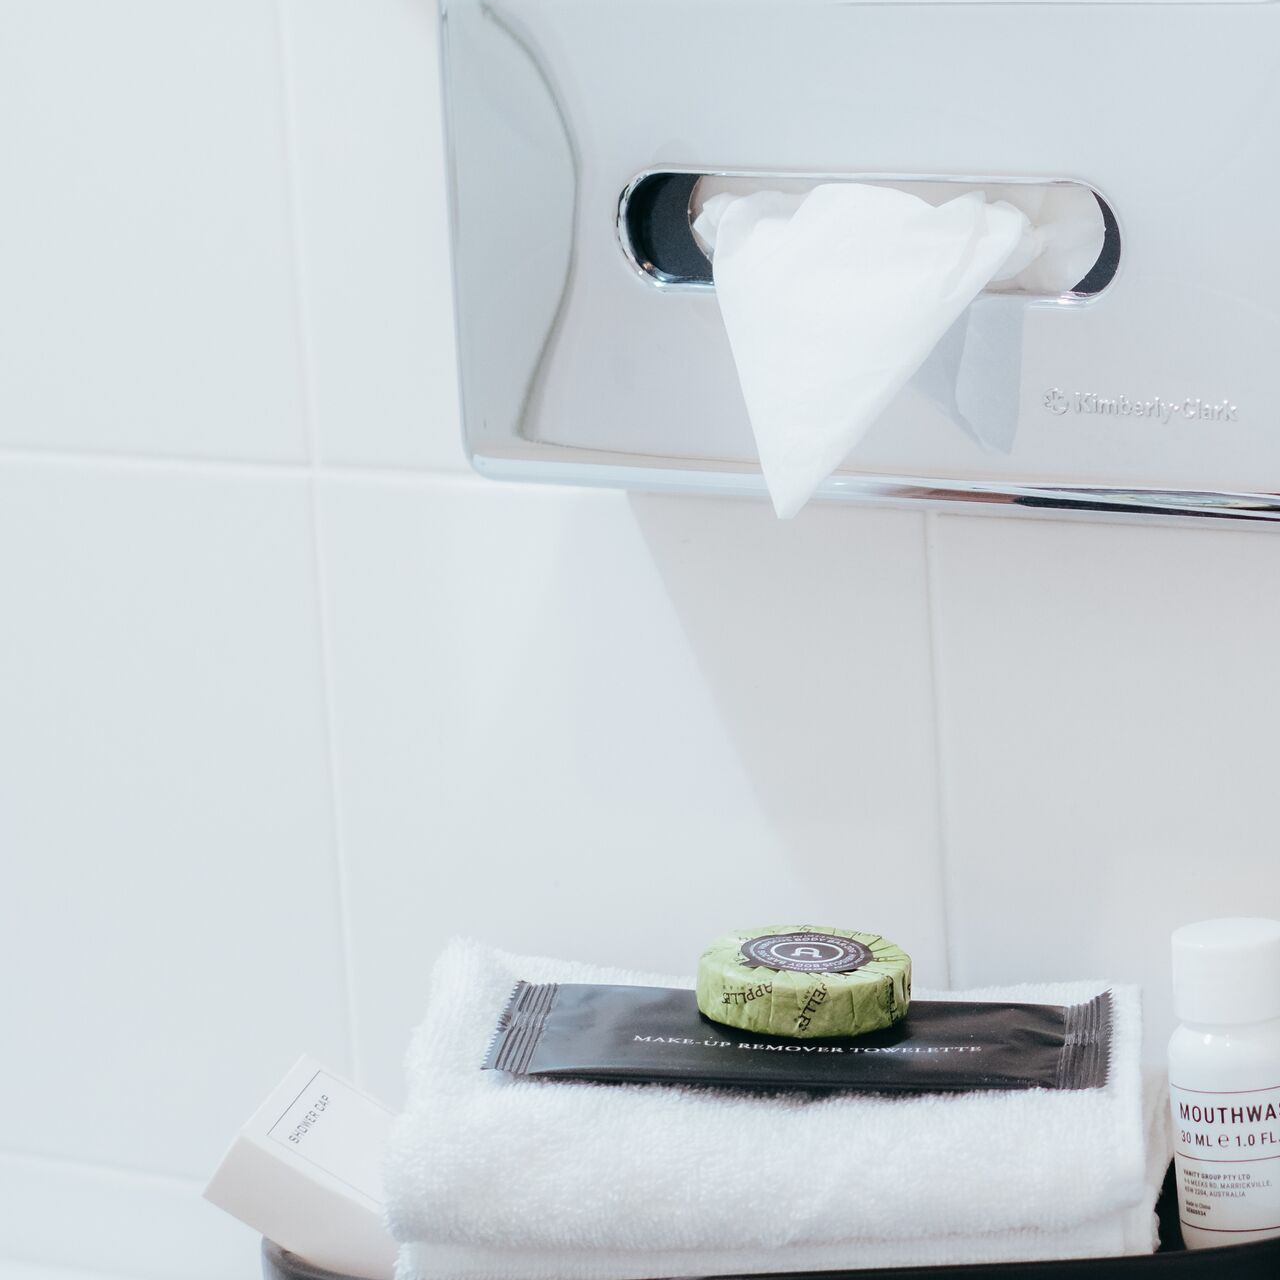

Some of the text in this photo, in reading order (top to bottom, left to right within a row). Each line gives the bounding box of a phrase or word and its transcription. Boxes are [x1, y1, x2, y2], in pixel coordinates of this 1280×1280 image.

[632, 1035, 982, 1054] MAKE-UP REMOVER TOWELETTE
[1181, 1130, 1191, 1144] 30
[1195, 1133, 1213, 1147] ML
[1235, 1134, 1255, 1147] 1.0
[1261, 1131, 1280, 1145] FL.
